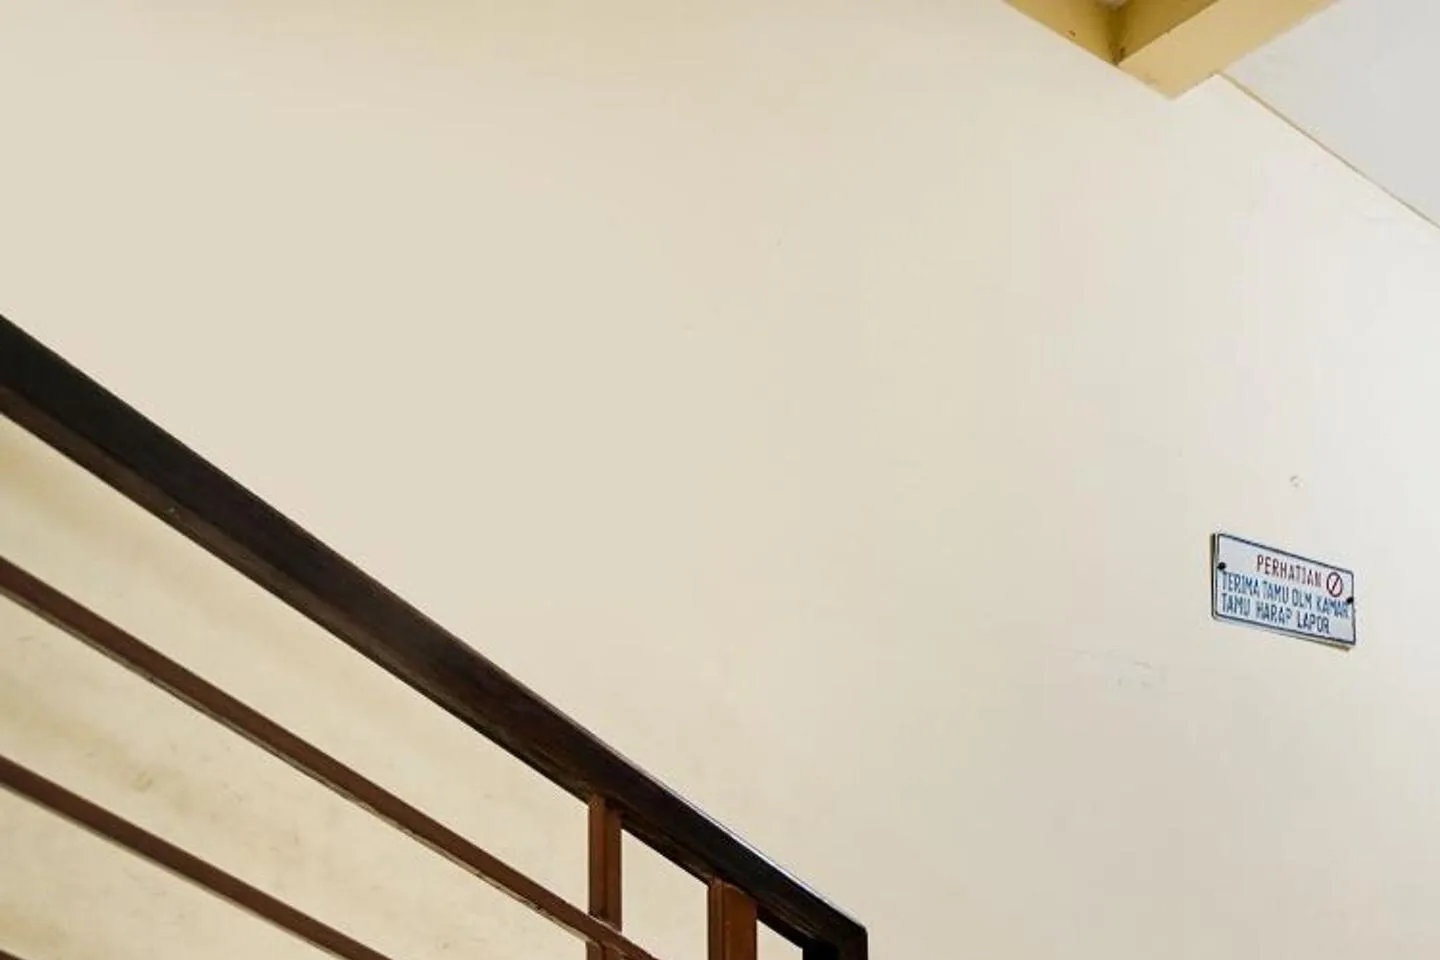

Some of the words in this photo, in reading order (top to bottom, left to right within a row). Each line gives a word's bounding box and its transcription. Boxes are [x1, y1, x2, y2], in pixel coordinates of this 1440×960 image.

[1221, 571, 1261, 599] TERIMA
[1262, 580, 1289, 604] TAMU
[1256, 554, 1322, 588] PERHATIAN
[1221, 593, 1251, 617] TAMU
[1255, 600, 1293, 625] HARAP
[1297, 610, 1330, 634] LAPOR
